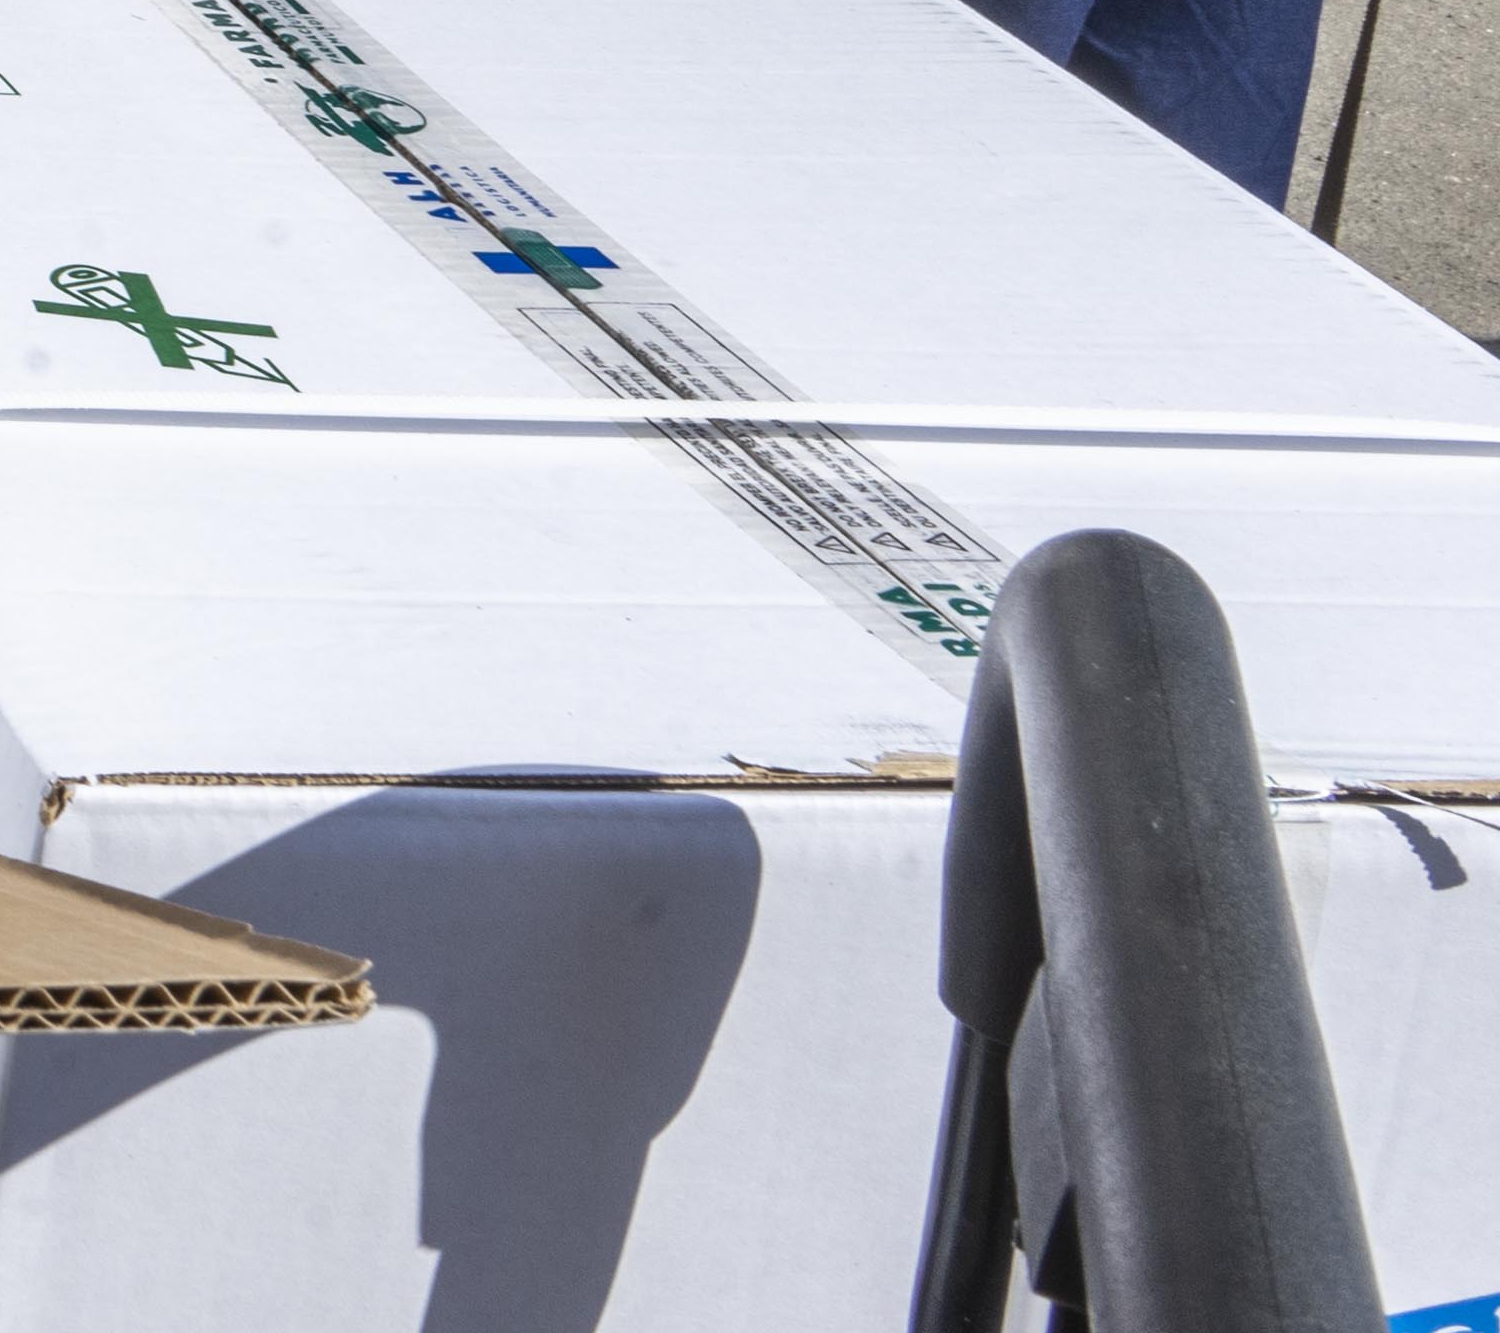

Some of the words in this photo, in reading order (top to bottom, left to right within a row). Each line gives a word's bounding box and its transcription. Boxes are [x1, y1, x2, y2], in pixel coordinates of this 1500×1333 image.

[193, 0, 285, 68] FARMA
[383, 171, 469, 223] ALH
[876, 585, 982, 658] RMA
